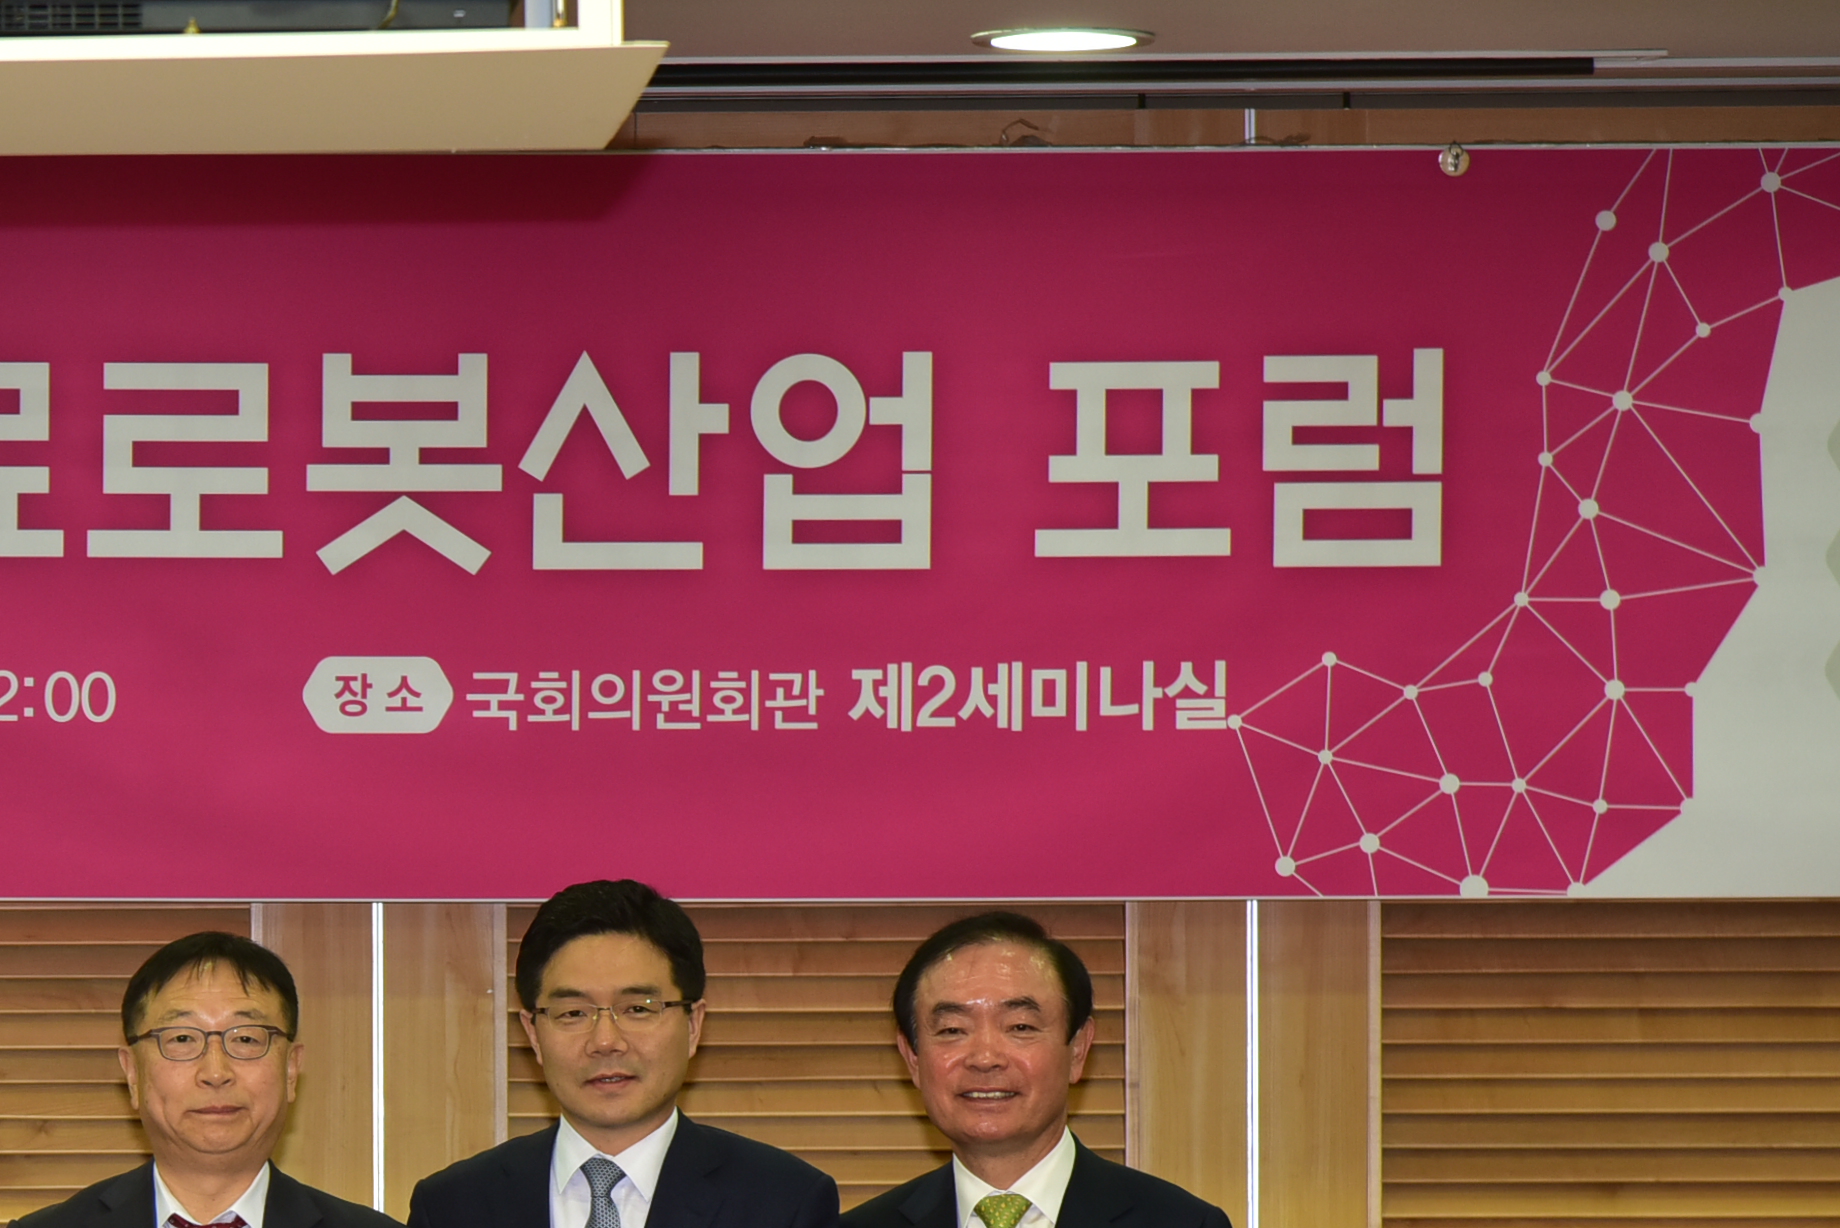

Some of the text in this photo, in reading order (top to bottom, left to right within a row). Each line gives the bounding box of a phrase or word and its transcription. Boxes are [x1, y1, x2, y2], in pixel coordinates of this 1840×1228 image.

[1034, 348, 1444, 568] 포럼
[466, 660, 1228, 732] 국회의원회관 제2세미나실
